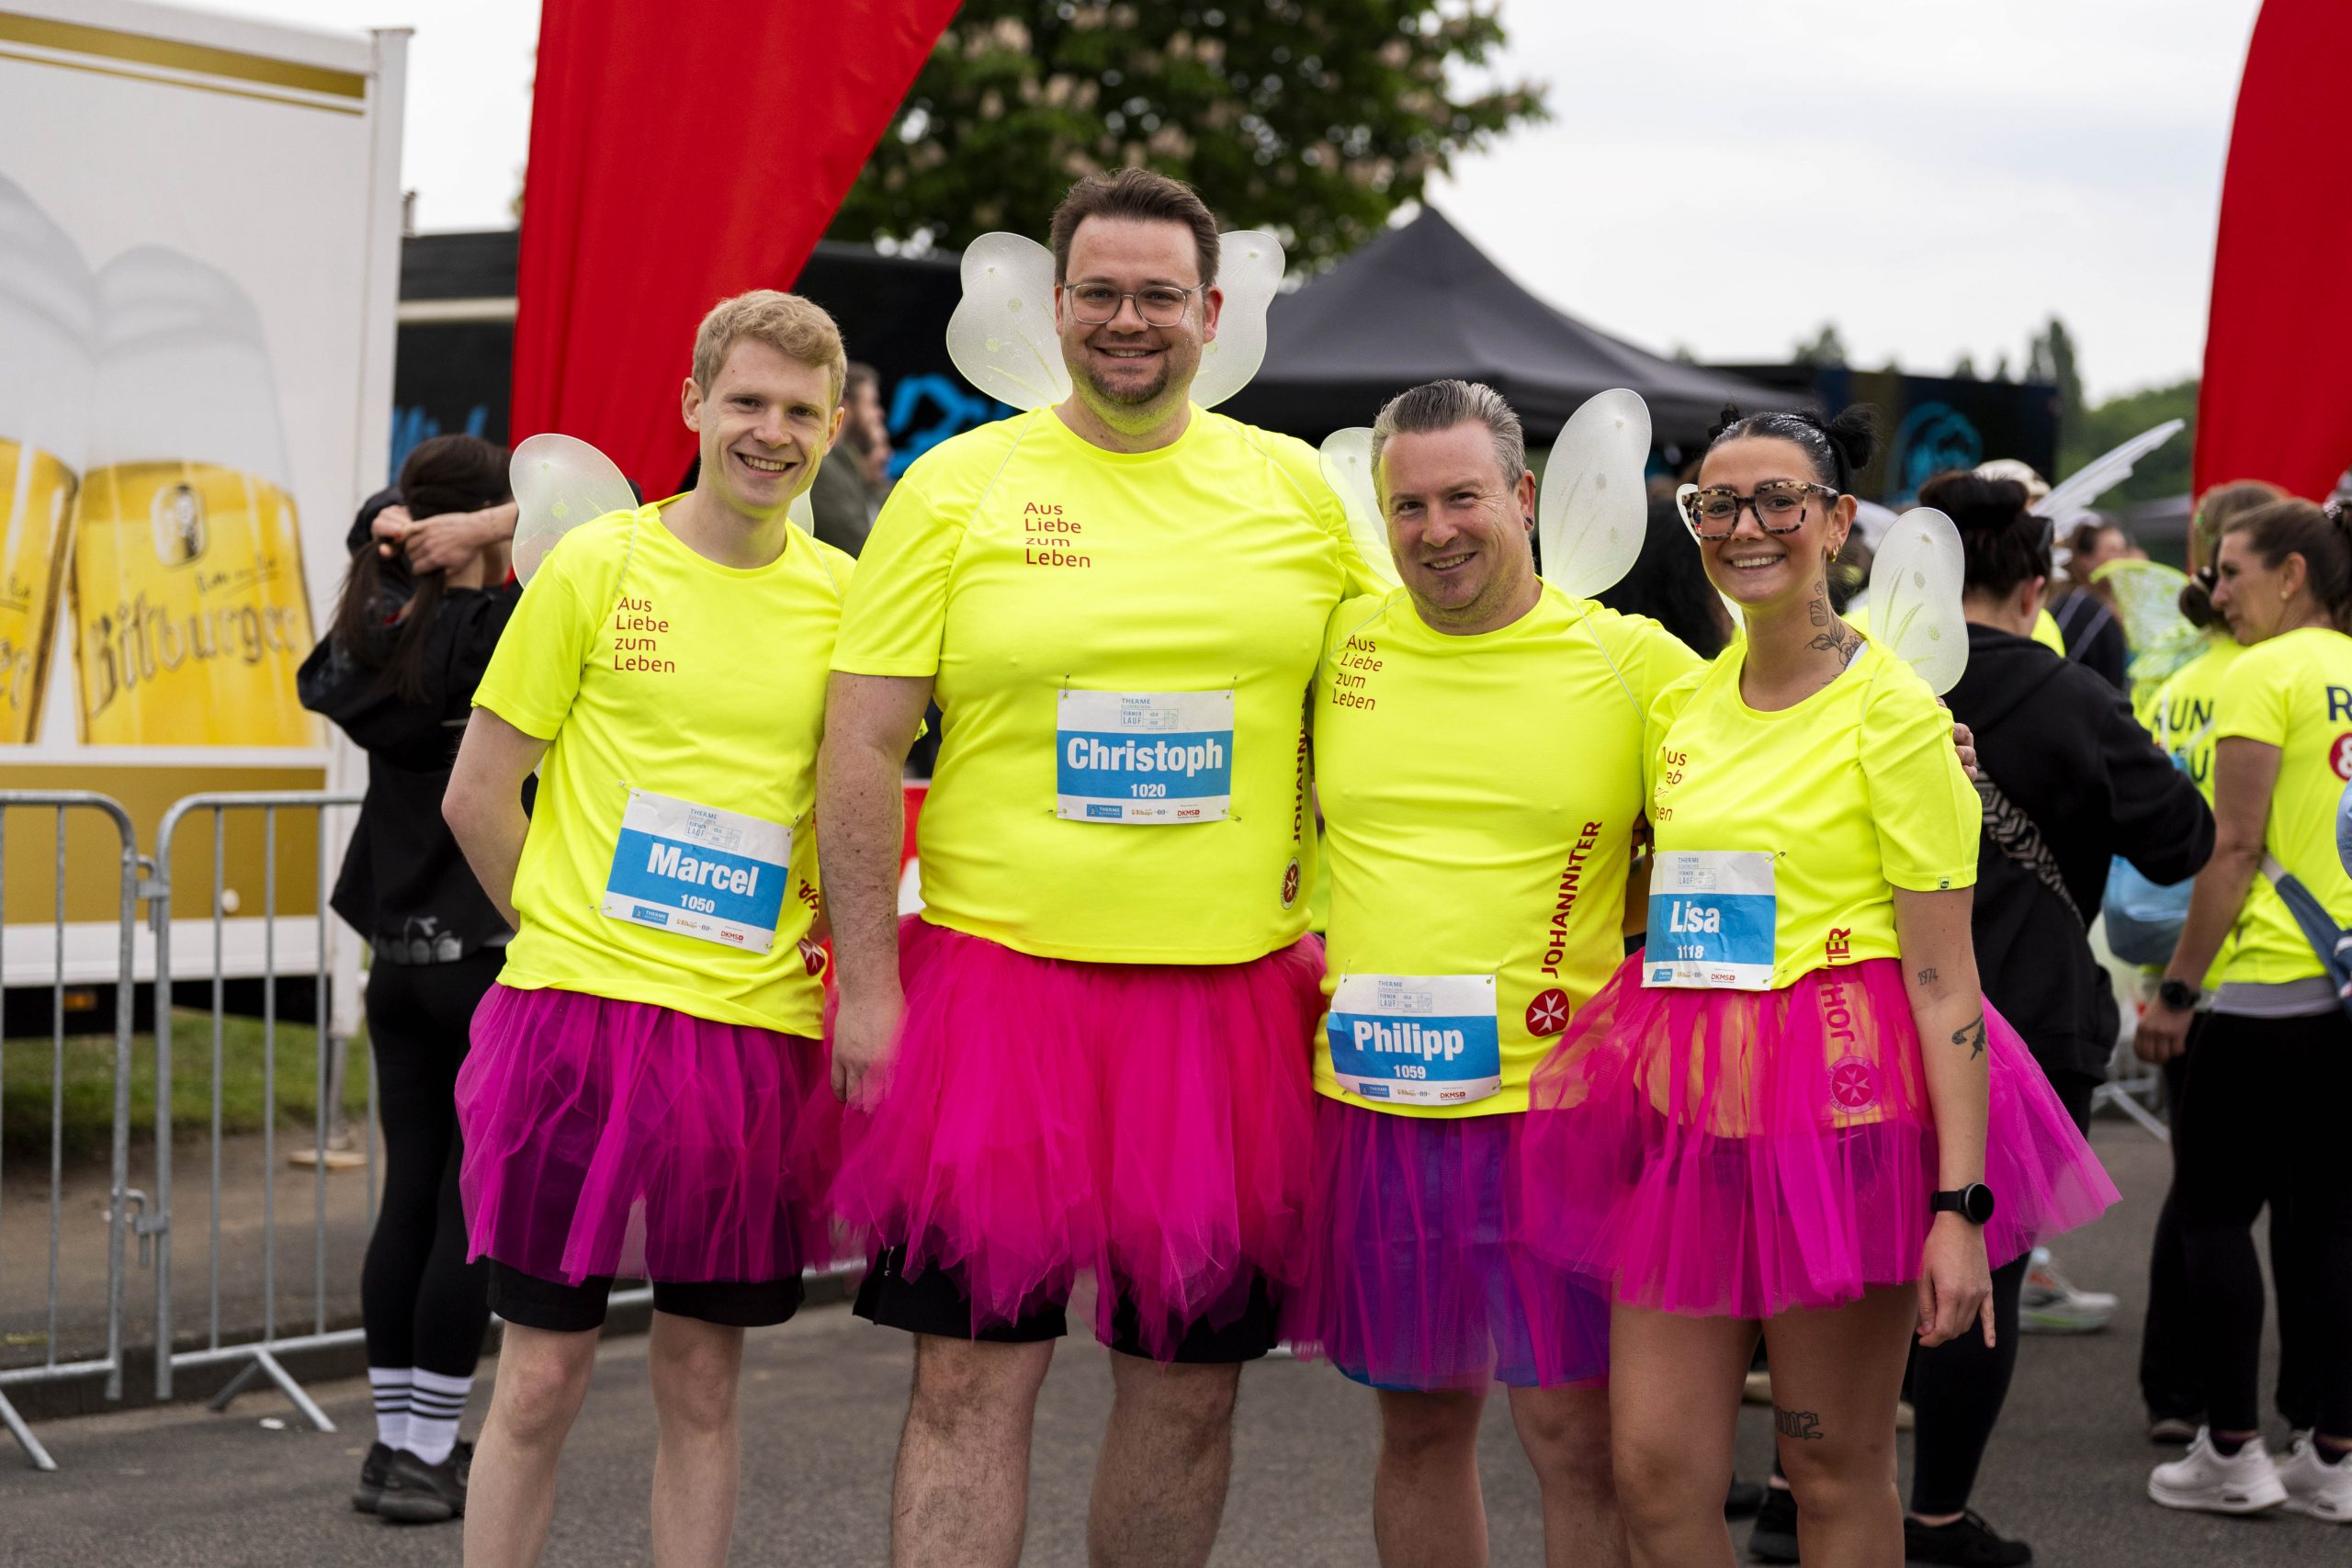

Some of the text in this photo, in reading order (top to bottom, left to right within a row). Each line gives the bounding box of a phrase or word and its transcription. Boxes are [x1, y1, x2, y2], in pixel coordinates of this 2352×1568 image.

[1023, 502, 1063, 515] Aus
[1024, 517, 1081, 534] Liebe
[1025, 537, 1070, 547] zum
[1026, 547, 1091, 569] Leben
[617, 596, 652, 613] Aus
[616, 615, 669, 633] Liebe
[615, 637, 656, 652] zum
[1346, 634, 1376, 653] Aus
[615, 654, 675, 673] Leben
[1340, 652, 1383, 671] Liebe
[1335, 672, 1366, 689] zum
[1332, 688, 1375, 711] Leben
[1123, 716, 1141, 725] LAUF
[1067, 737, 1223, 778] Christoph
[1130, 784, 1166, 797] 1020
[646, 841, 760, 897] Marcel
[681, 894, 716, 914] 1050
[1541, 821, 1603, 979] JOHANNITER
[1669, 900, 1721, 933] Lisa
[1677, 944, 1704, 959] 1118
[1353, 1021, 1464, 1061] Philipp
[1393, 1065, 1427, 1079] 1059
